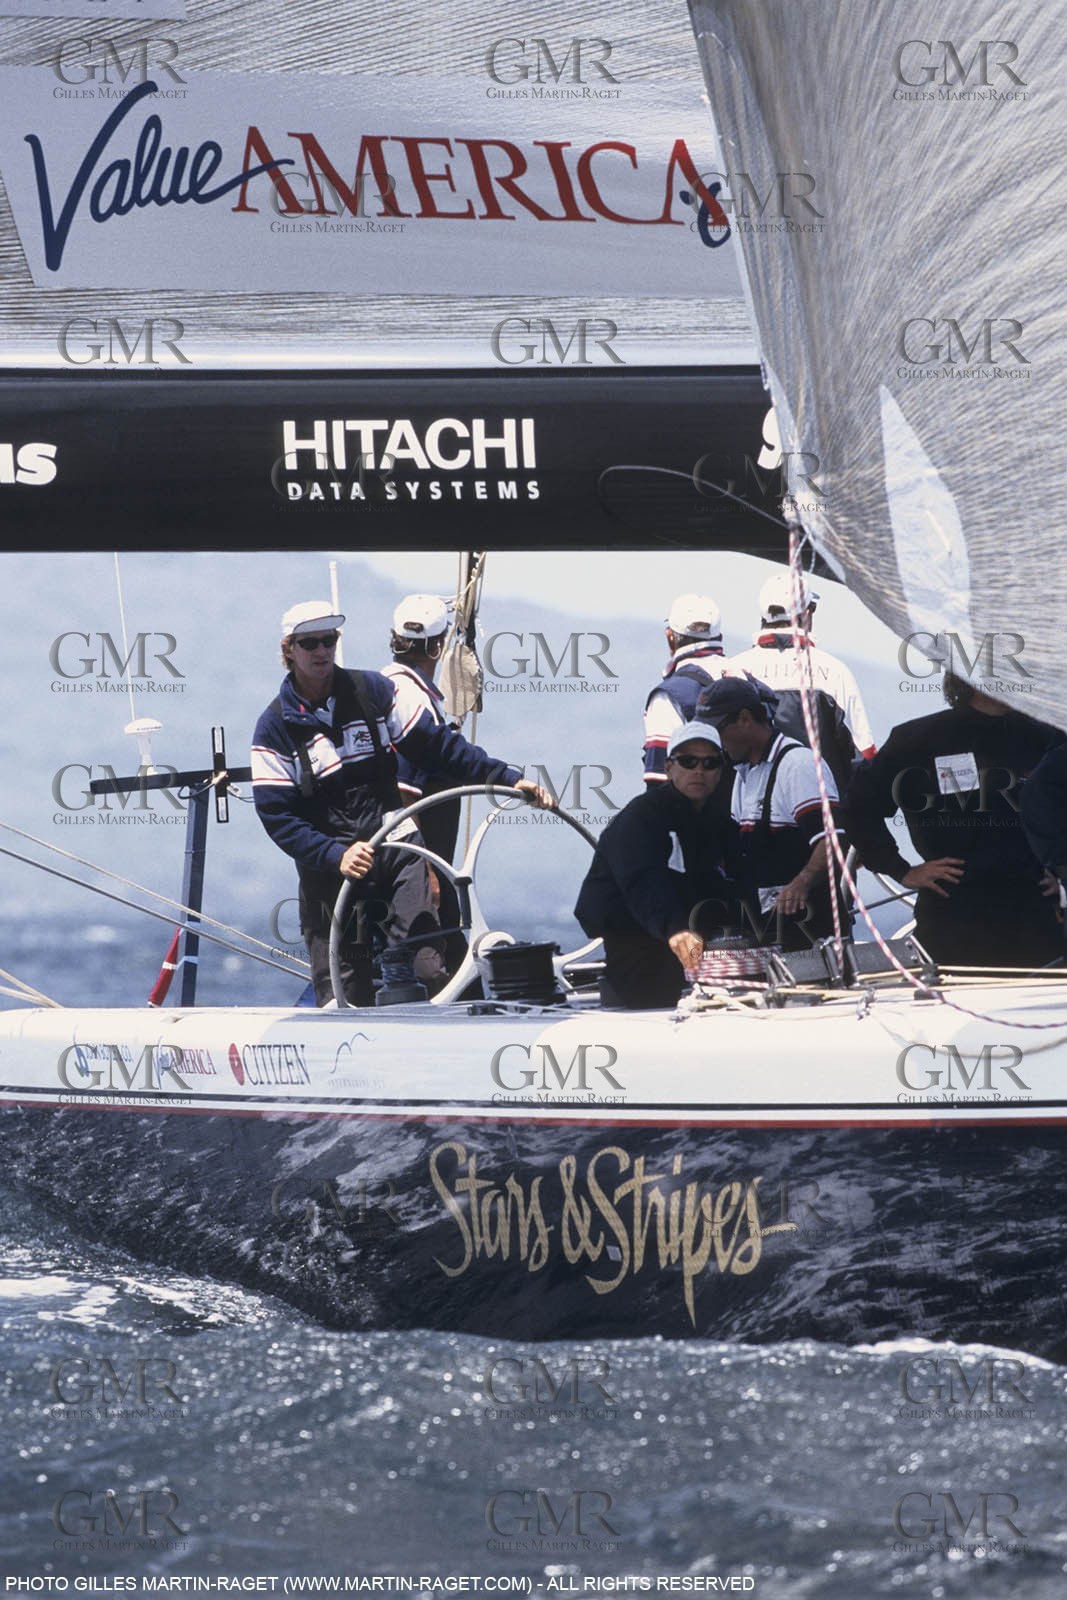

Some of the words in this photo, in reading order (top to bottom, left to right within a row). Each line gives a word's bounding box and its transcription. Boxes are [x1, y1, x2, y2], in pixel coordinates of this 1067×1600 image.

[24, 80, 294, 271] Value
[232, 126, 729, 225] AMERICA
[283, 417, 536, 470] HITACHI
[287, 482, 366, 500] DATA
[384, 480, 540, 500] SYSTEMS
[243, 1044, 311, 1086] CITIZEN
[429, 1142, 554, 1278] Stars
[559, 1154, 604, 1265] &
[584, 1145, 796, 1329] Stripes
